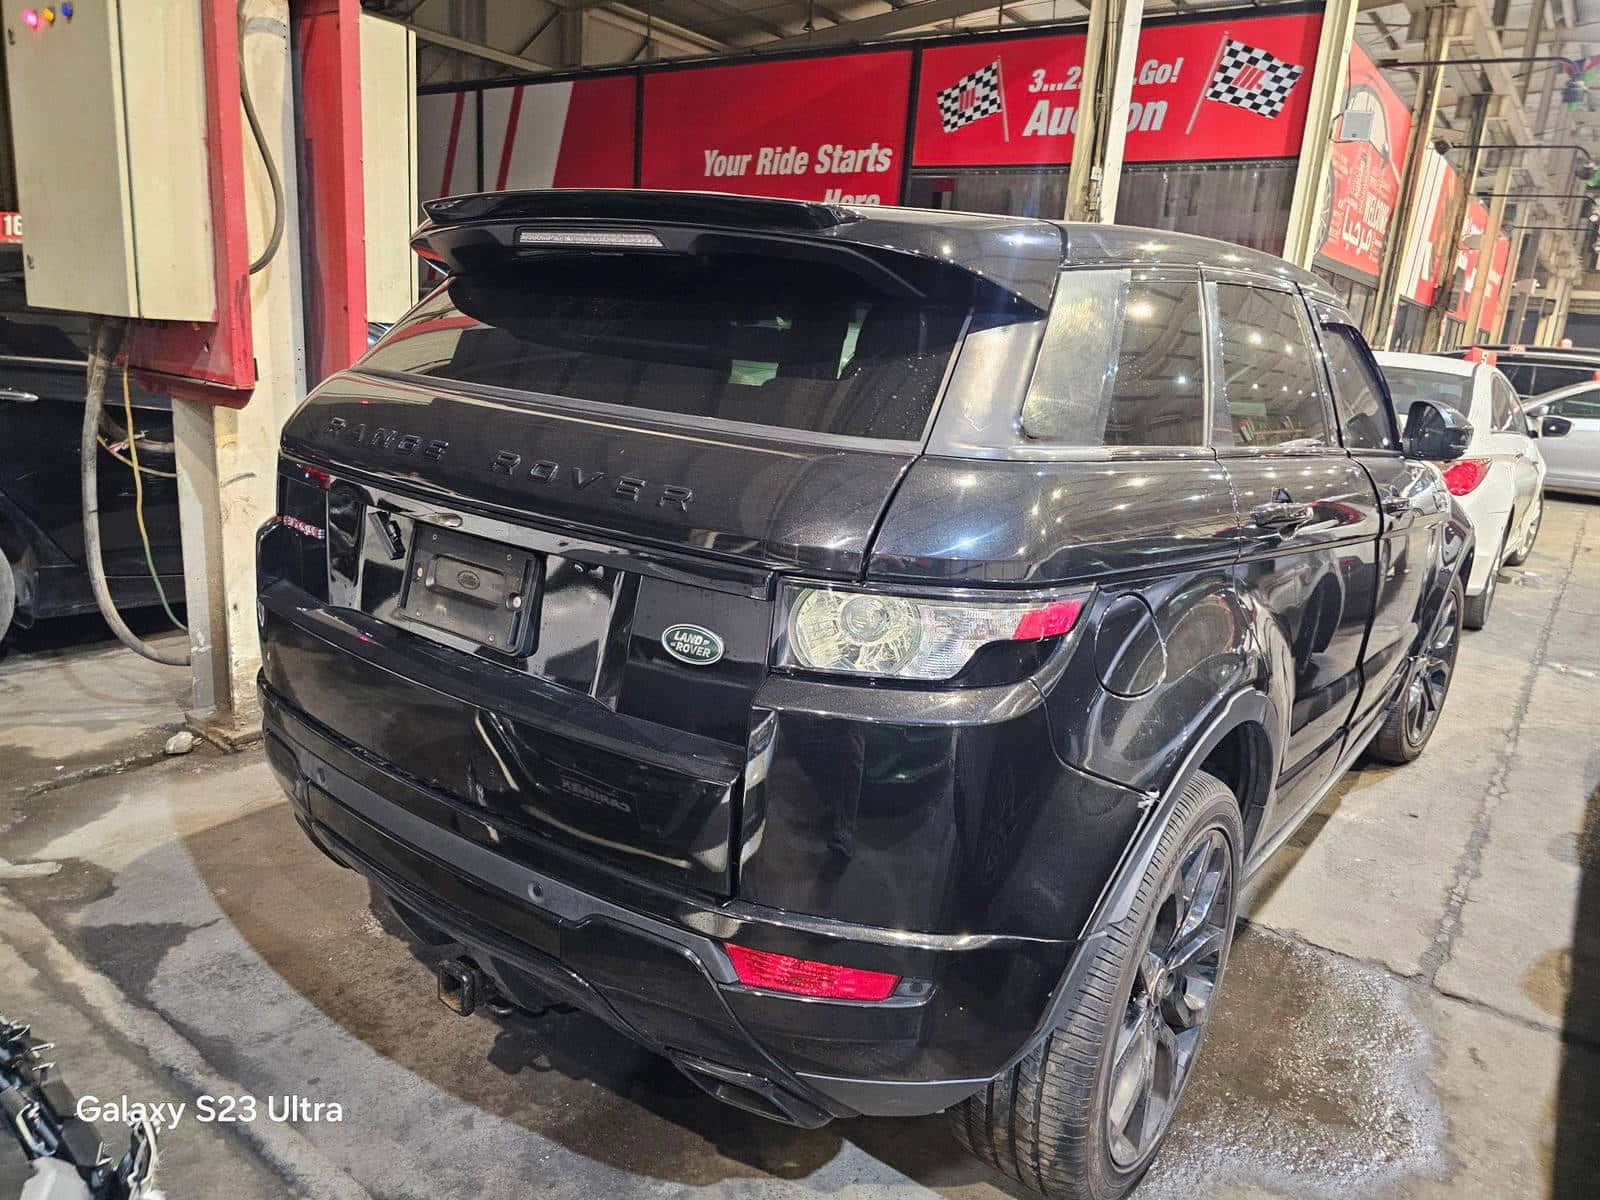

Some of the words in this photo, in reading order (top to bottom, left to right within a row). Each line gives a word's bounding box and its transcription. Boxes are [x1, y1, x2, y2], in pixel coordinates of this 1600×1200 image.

[1022, 100, 1168, 136] Auon
[704, 150, 752, 177] Your
[756, 146, 809, 176] Ride
[814, 143, 893, 174] Starts
[325, 416, 450, 462] RANGE
[487, 449, 696, 513] ROVER
[673, 630, 704, 647] LAND
[674, 641, 712, 658] ROVER
